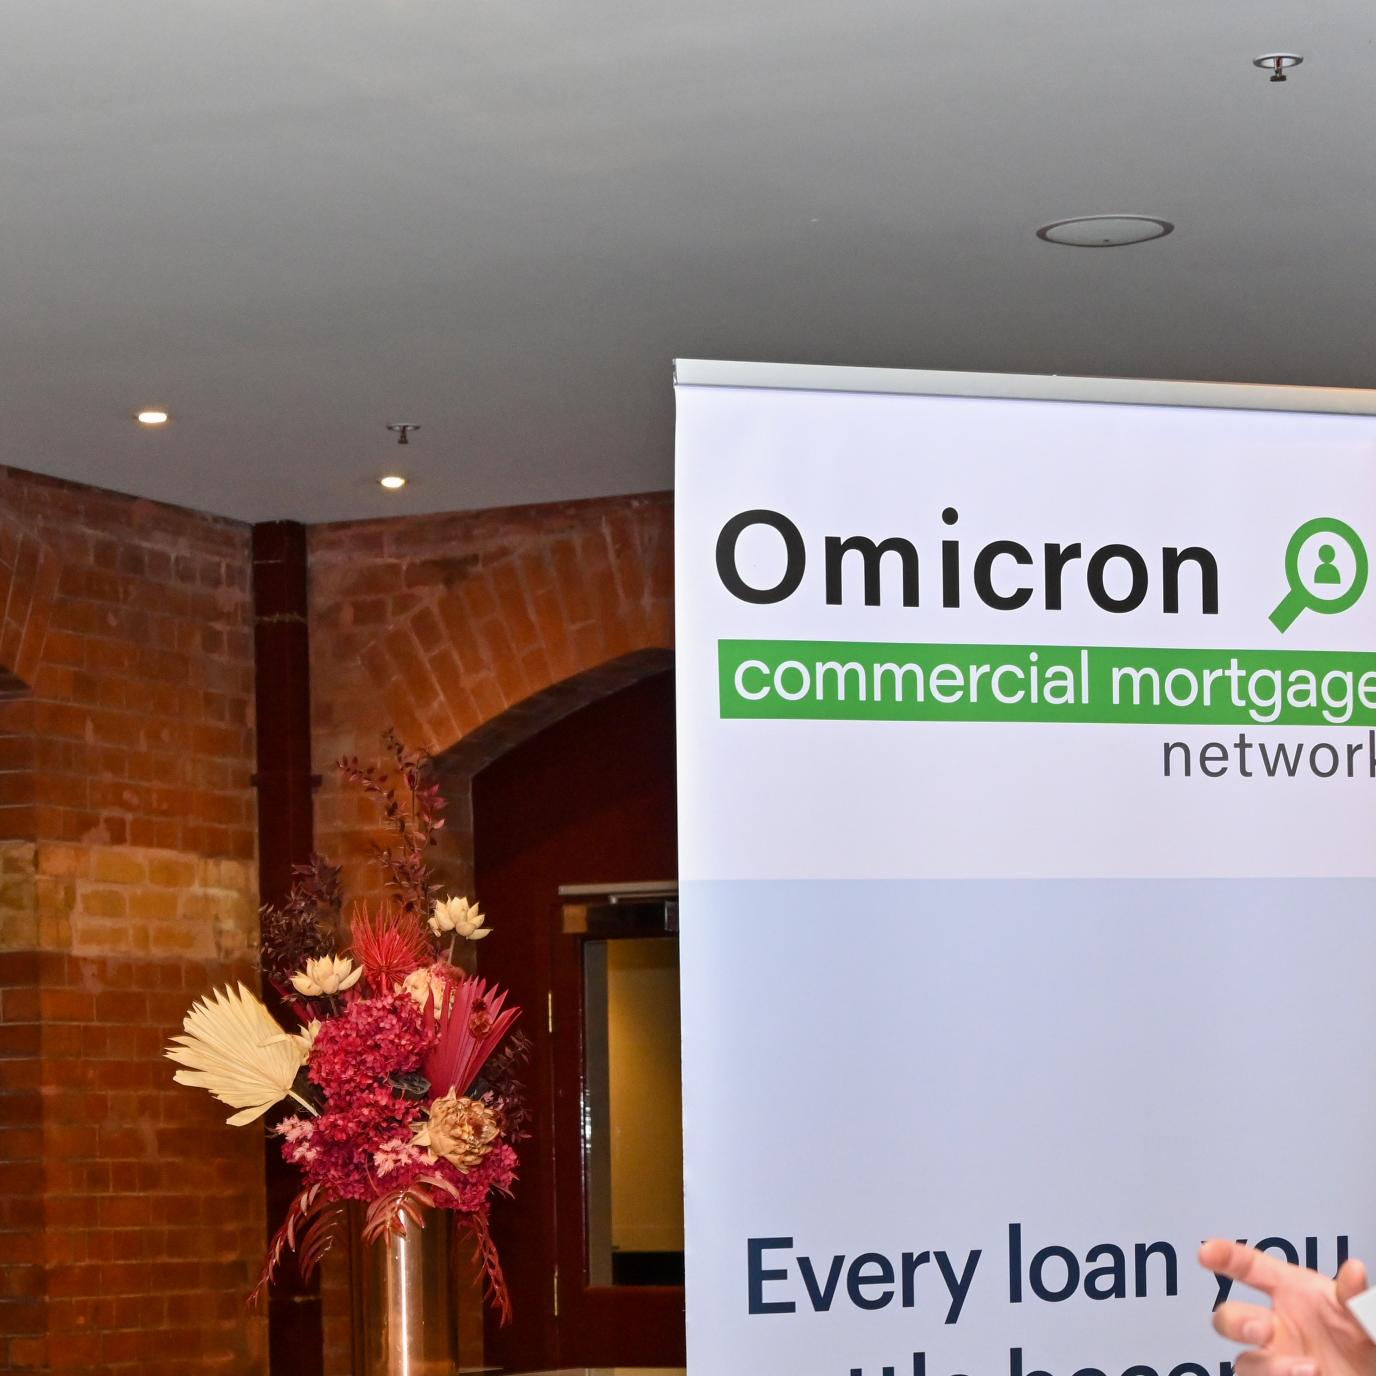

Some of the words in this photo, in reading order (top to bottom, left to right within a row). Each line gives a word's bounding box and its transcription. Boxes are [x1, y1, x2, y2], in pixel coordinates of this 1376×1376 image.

[715, 507, 1219, 614] Omicron
[734, 650, 1090, 706] commercial
[747, 1236, 983, 1325] Every
[1009, 1222, 1178, 1304] loan
